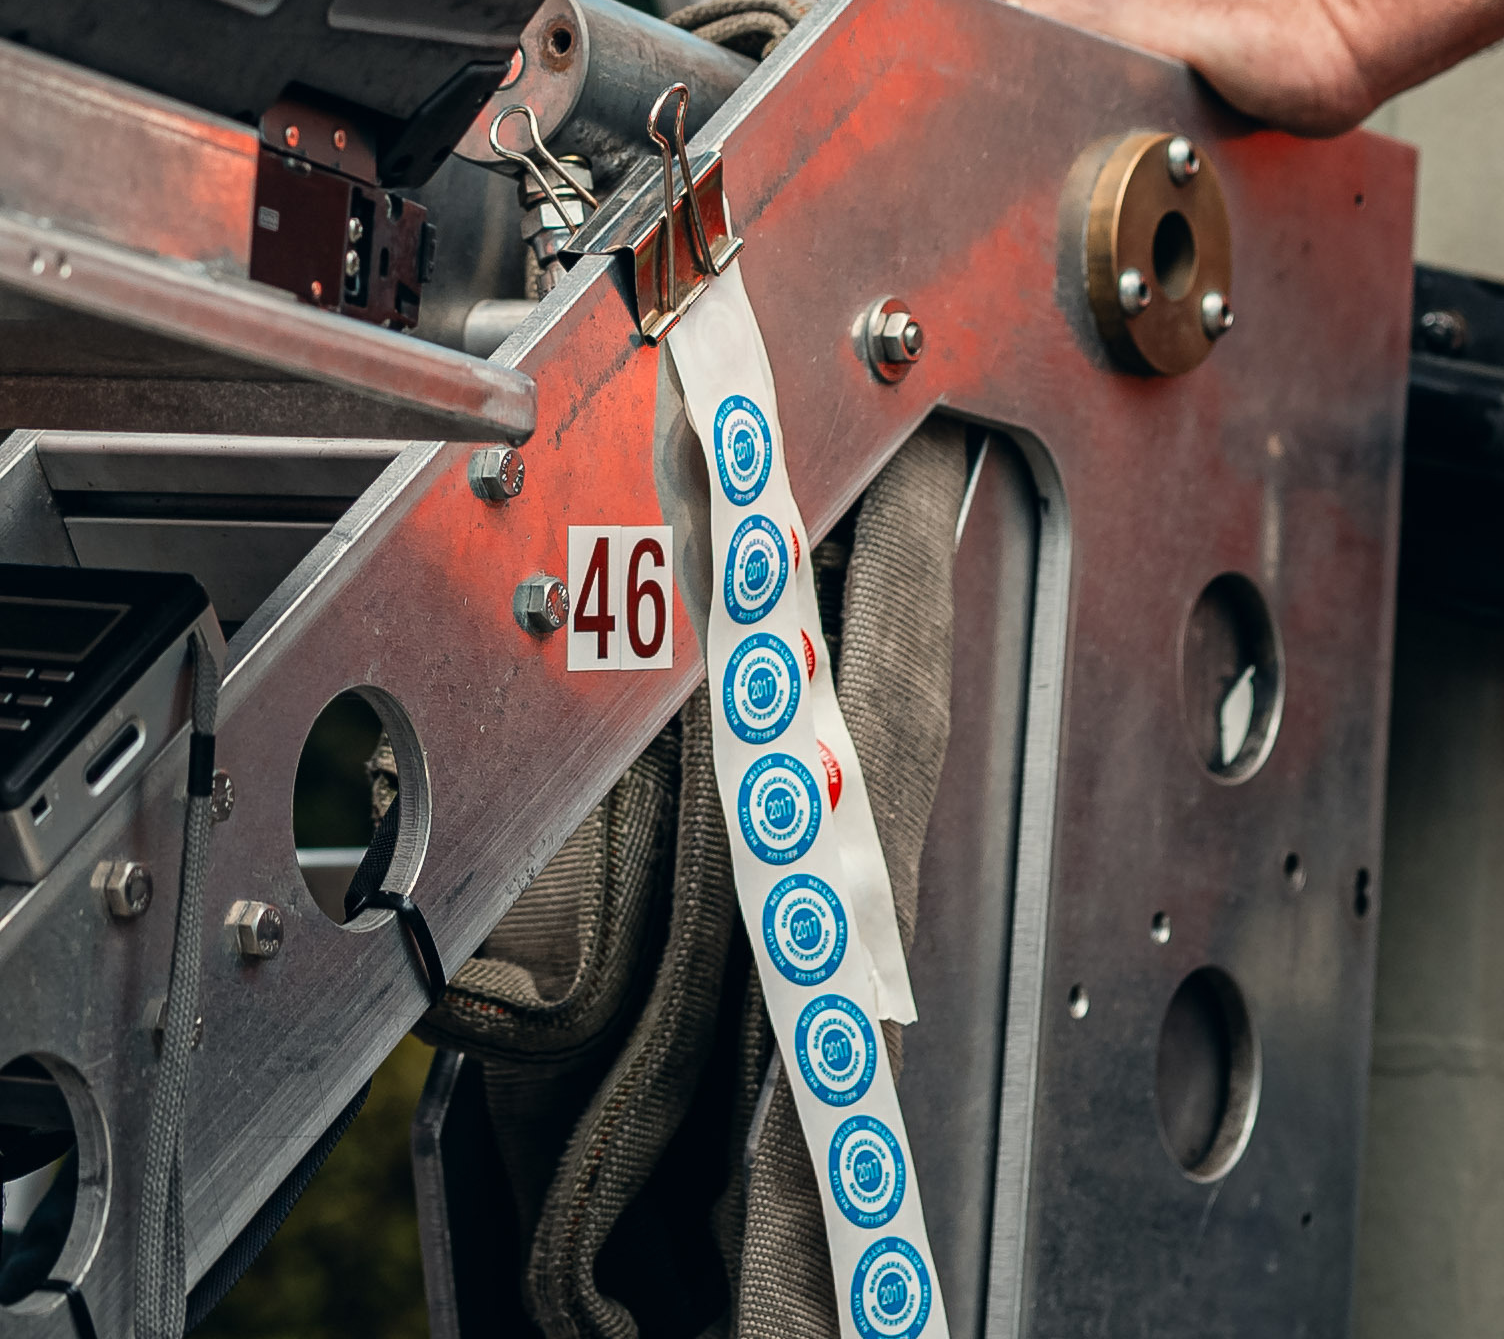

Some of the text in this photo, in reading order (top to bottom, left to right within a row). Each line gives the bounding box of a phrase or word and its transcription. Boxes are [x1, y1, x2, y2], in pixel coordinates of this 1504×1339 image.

[735, 438, 752, 461] 2017
[747, 557, 766, 582] 2017
[572, 536, 667, 661] 46
[751, 676, 773, 700] 2017
[768, 796, 792, 820] 2017
[794, 917, 818, 941] 2017
[825, 1038, 848, 1062] 2017
[857, 1159, 879, 1183] 2017
[881, 1281, 904, 1305] 2017
